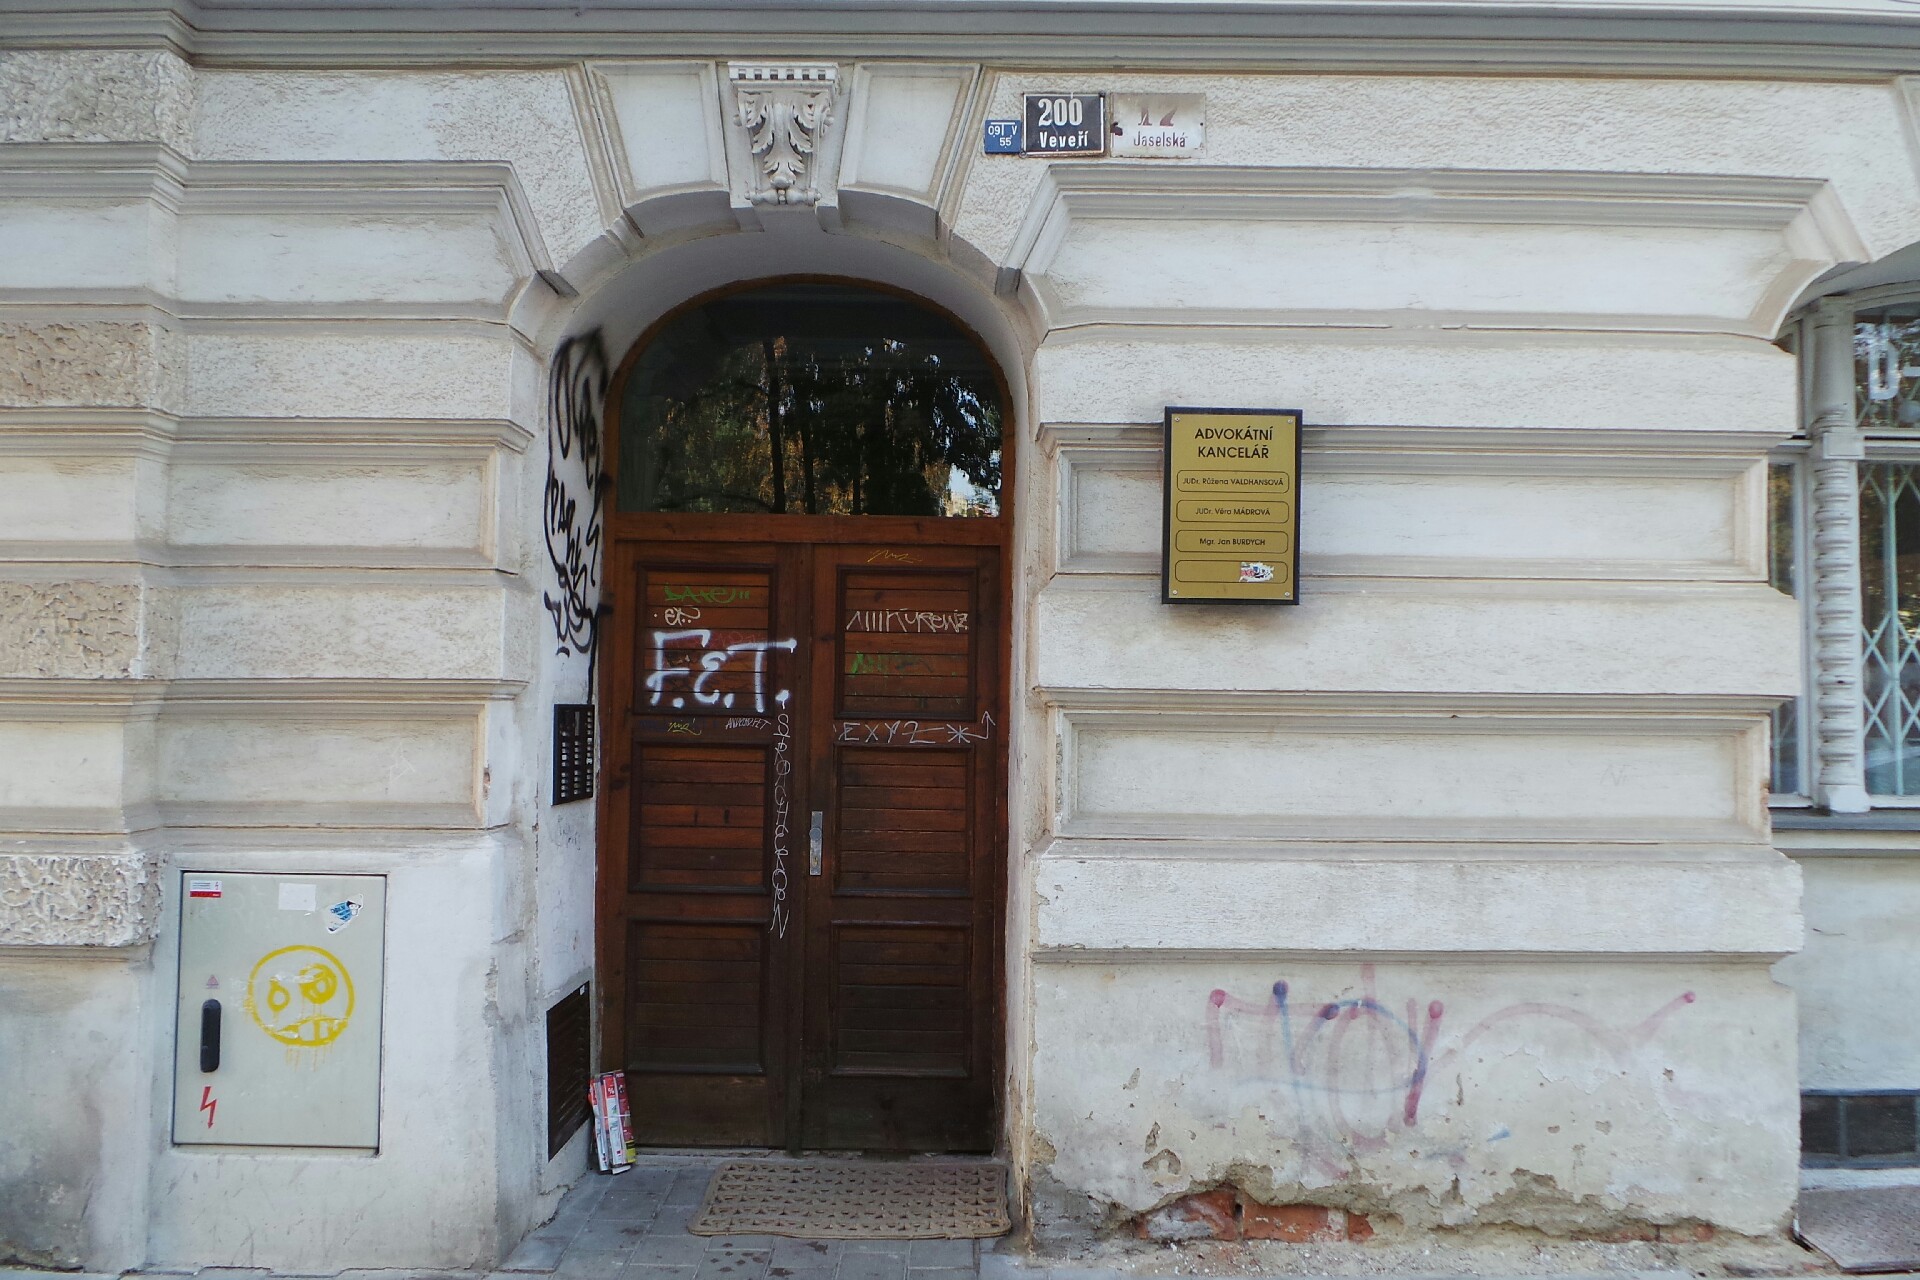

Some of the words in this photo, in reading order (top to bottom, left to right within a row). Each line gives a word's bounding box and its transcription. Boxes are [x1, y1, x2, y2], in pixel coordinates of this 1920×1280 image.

[1038, 98, 1083, 127] 200
[1039, 131, 1089, 148] Veveří
[1133, 131, 1186, 148] Jaselská
[1194, 425, 1274, 441] ADVOKÁTNÍ
[1197, 444, 1269, 459] KANCELÁŘ
[1202, 477, 1229, 486] Růžena
[1230, 477, 1284, 487] VALDHANSOVÁ
[1195, 508, 1213, 516] JUDr.
[1215, 507, 1232, 516] Věra
[1233, 507, 1271, 516] MÁDROVÁ
[1199, 538, 1215, 547] Mgr.
[1217, 538, 1231, 546] Jan
[1232, 538, 1266, 547] BURDYCH
